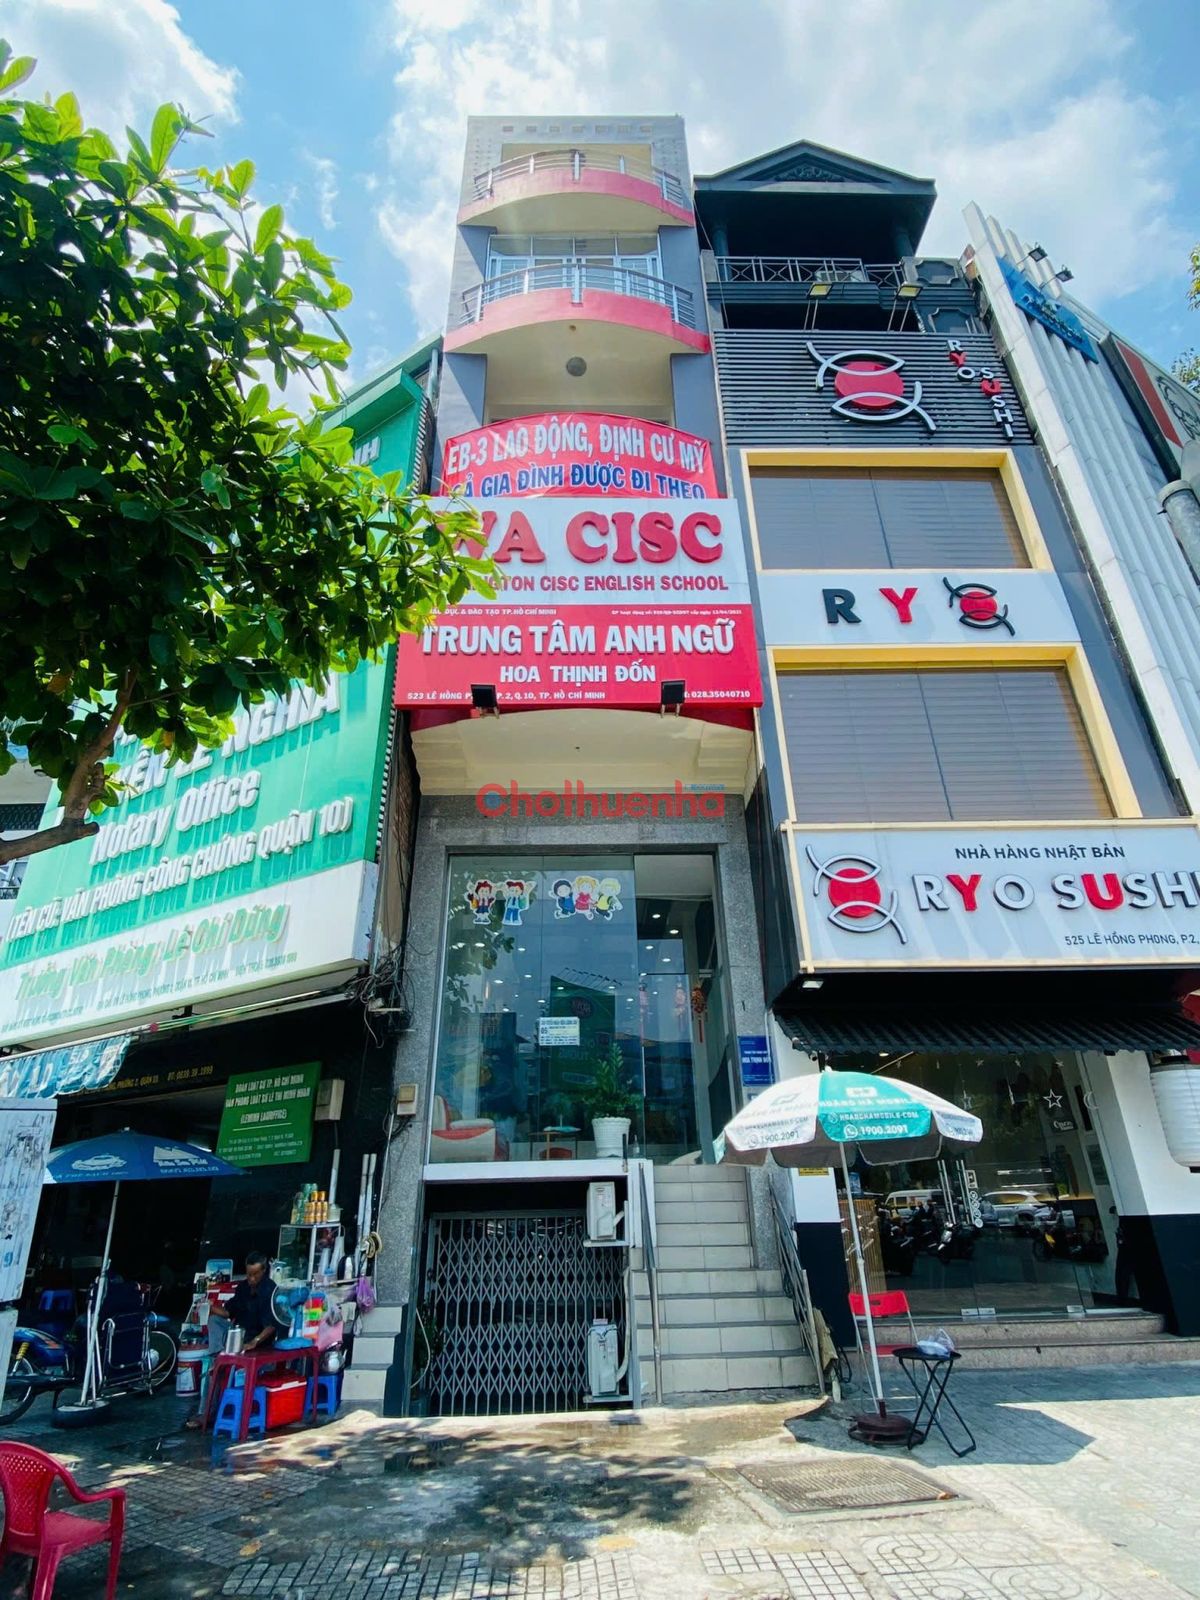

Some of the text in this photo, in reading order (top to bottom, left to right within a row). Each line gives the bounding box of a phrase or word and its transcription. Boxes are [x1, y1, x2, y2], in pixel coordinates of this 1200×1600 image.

[447, 415, 704, 475] EB-3 LAO ĐỘNG, ĐỊNH CƯ MỸ
[481, 472, 511, 498] GIA
[517, 462, 564, 491] ĐÌNH
[570, 460, 625, 493] ĐƯỢC
[631, 468, 652, 492] ĐI
[655, 474, 705, 499] THEO
[565, 511, 723, 564] CISC
[540, 575, 579, 592] CISC
[584, 575, 655, 592] ENGLISH
[660, 575, 729, 591] SCHOOL
[422, 617, 736, 655] TRUNG TÂM ANH NGỮ
[500, 658, 656, 688] HOA THỊNH ĐỐN
[407, 691, 424, 700] 523
[427, 690, 437, 700] LÊ
[439, 689, 463, 700] HỒNG
[554, 688, 565, 700] HỒ
[567, 689, 583, 700] CHÍ
[584, 691, 606, 700] MINH
[691, 690, 751, 699] 028.35040710
[89, 804, 172, 866] Notary
[175, 770, 261, 832] Office
[89, 870, 145, 915] PHÒNG
[142, 855, 192, 897] CÔNG
[190, 832, 257, 880] CHỨNG
[256, 808, 316, 860] QUẬN
[955, 843, 1125, 861] NHÀ HÀNG NHẬT BẢN
[911, 873, 1035, 912] RYO
[1065, 935, 1085, 946] 525
[1088, 933, 1101, 945] LÊ
[1104, 931, 1136, 946] HỒNG
[1138, 934, 1179, 945] PHONG,
[860, 1124, 908, 1135] 1900.2091
